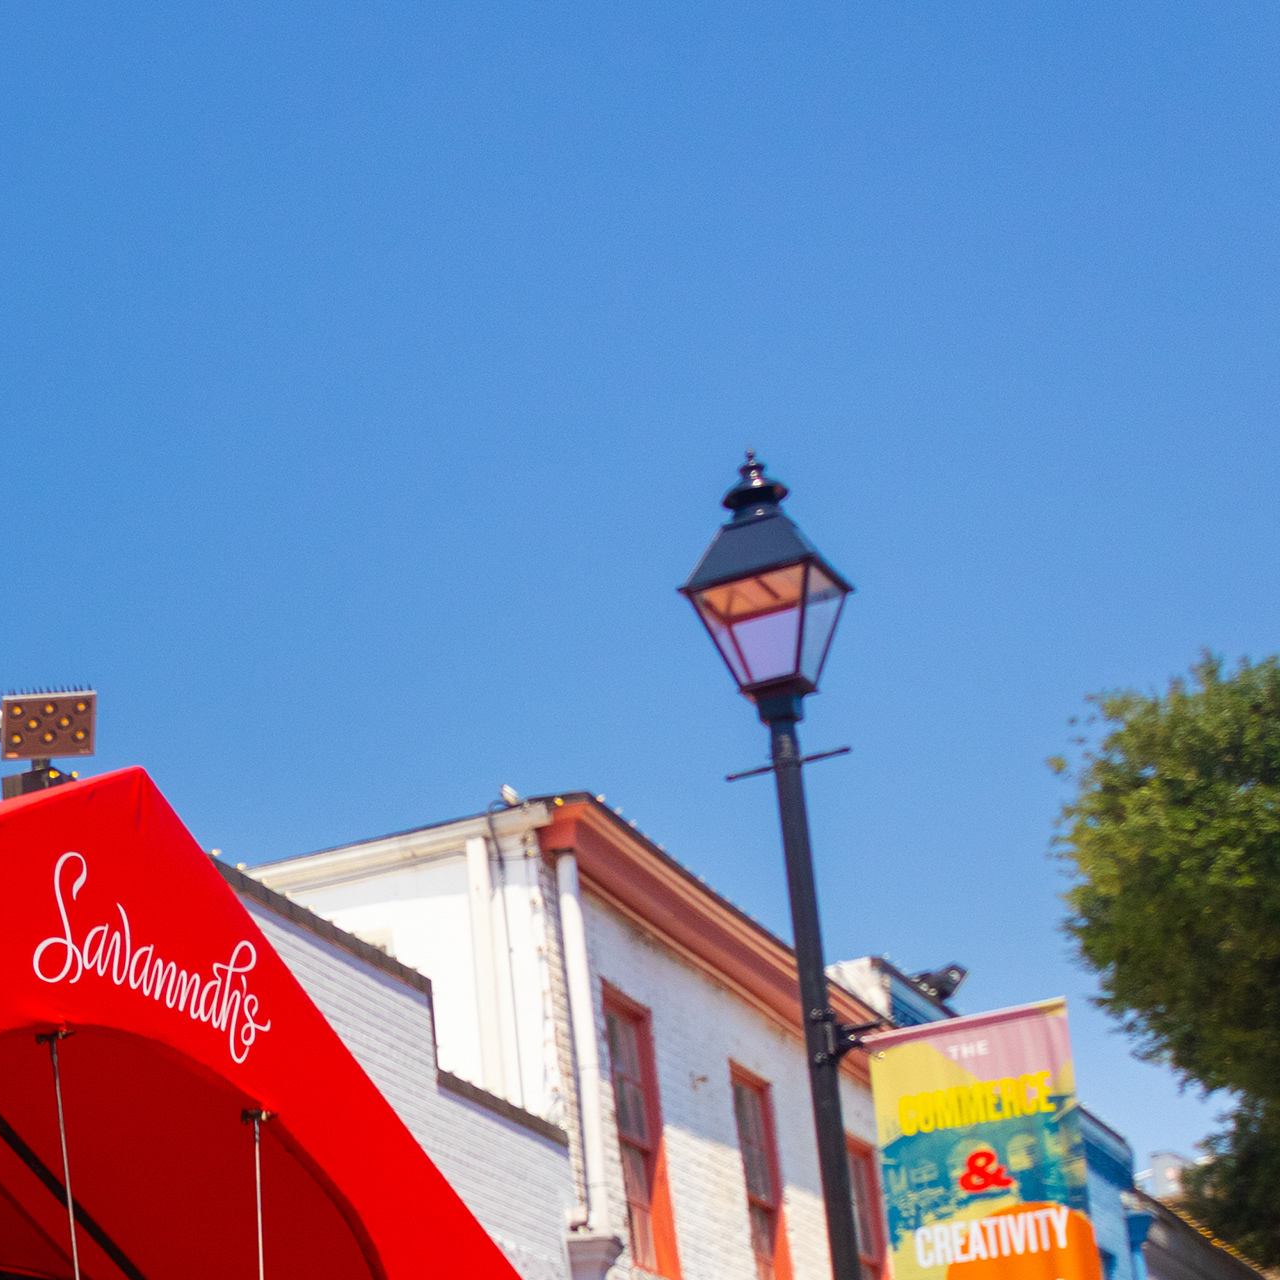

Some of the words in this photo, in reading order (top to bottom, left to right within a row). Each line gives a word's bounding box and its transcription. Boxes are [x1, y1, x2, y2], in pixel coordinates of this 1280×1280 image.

[32, 851, 271, 1064] Savannah's
[947, 1039, 989, 1060] THE
[898, 1070, 1056, 1137] COMMERCE
[958, 1149, 1015, 1192] &
[914, 1205, 1069, 1270] CREATIVITY
